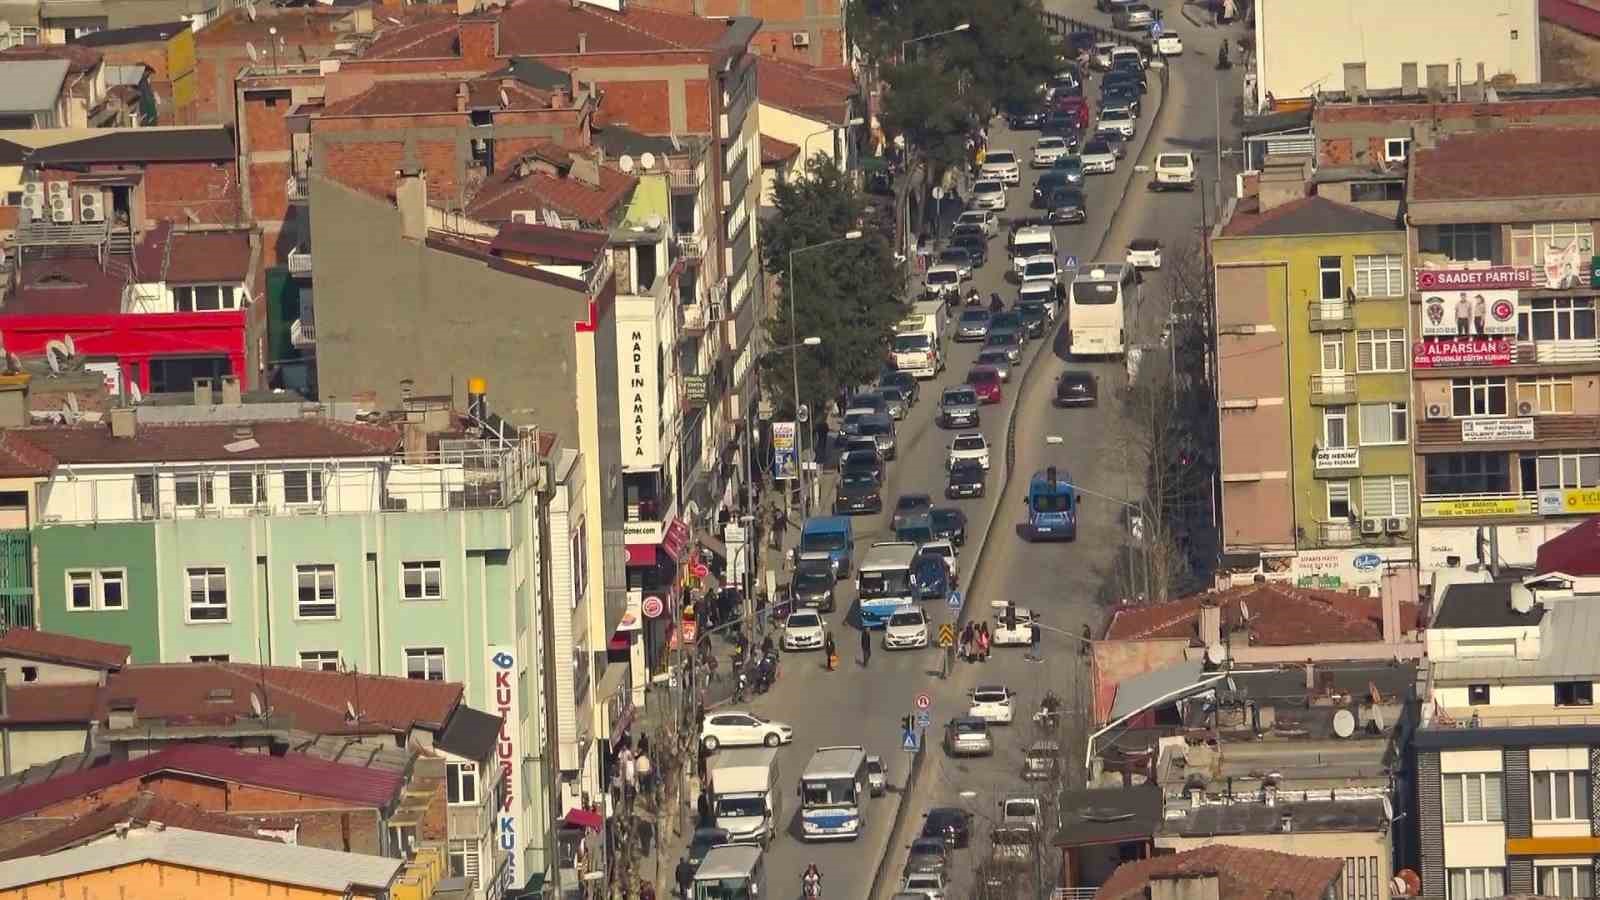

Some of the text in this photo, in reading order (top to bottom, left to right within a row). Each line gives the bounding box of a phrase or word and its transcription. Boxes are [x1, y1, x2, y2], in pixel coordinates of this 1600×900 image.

[1438, 270, 1530, 284] SAADET PARTİSİ
[1427, 342, 1498, 355] ALPARSLAN
[631, 331, 644, 457] MADE IN AMASYA
